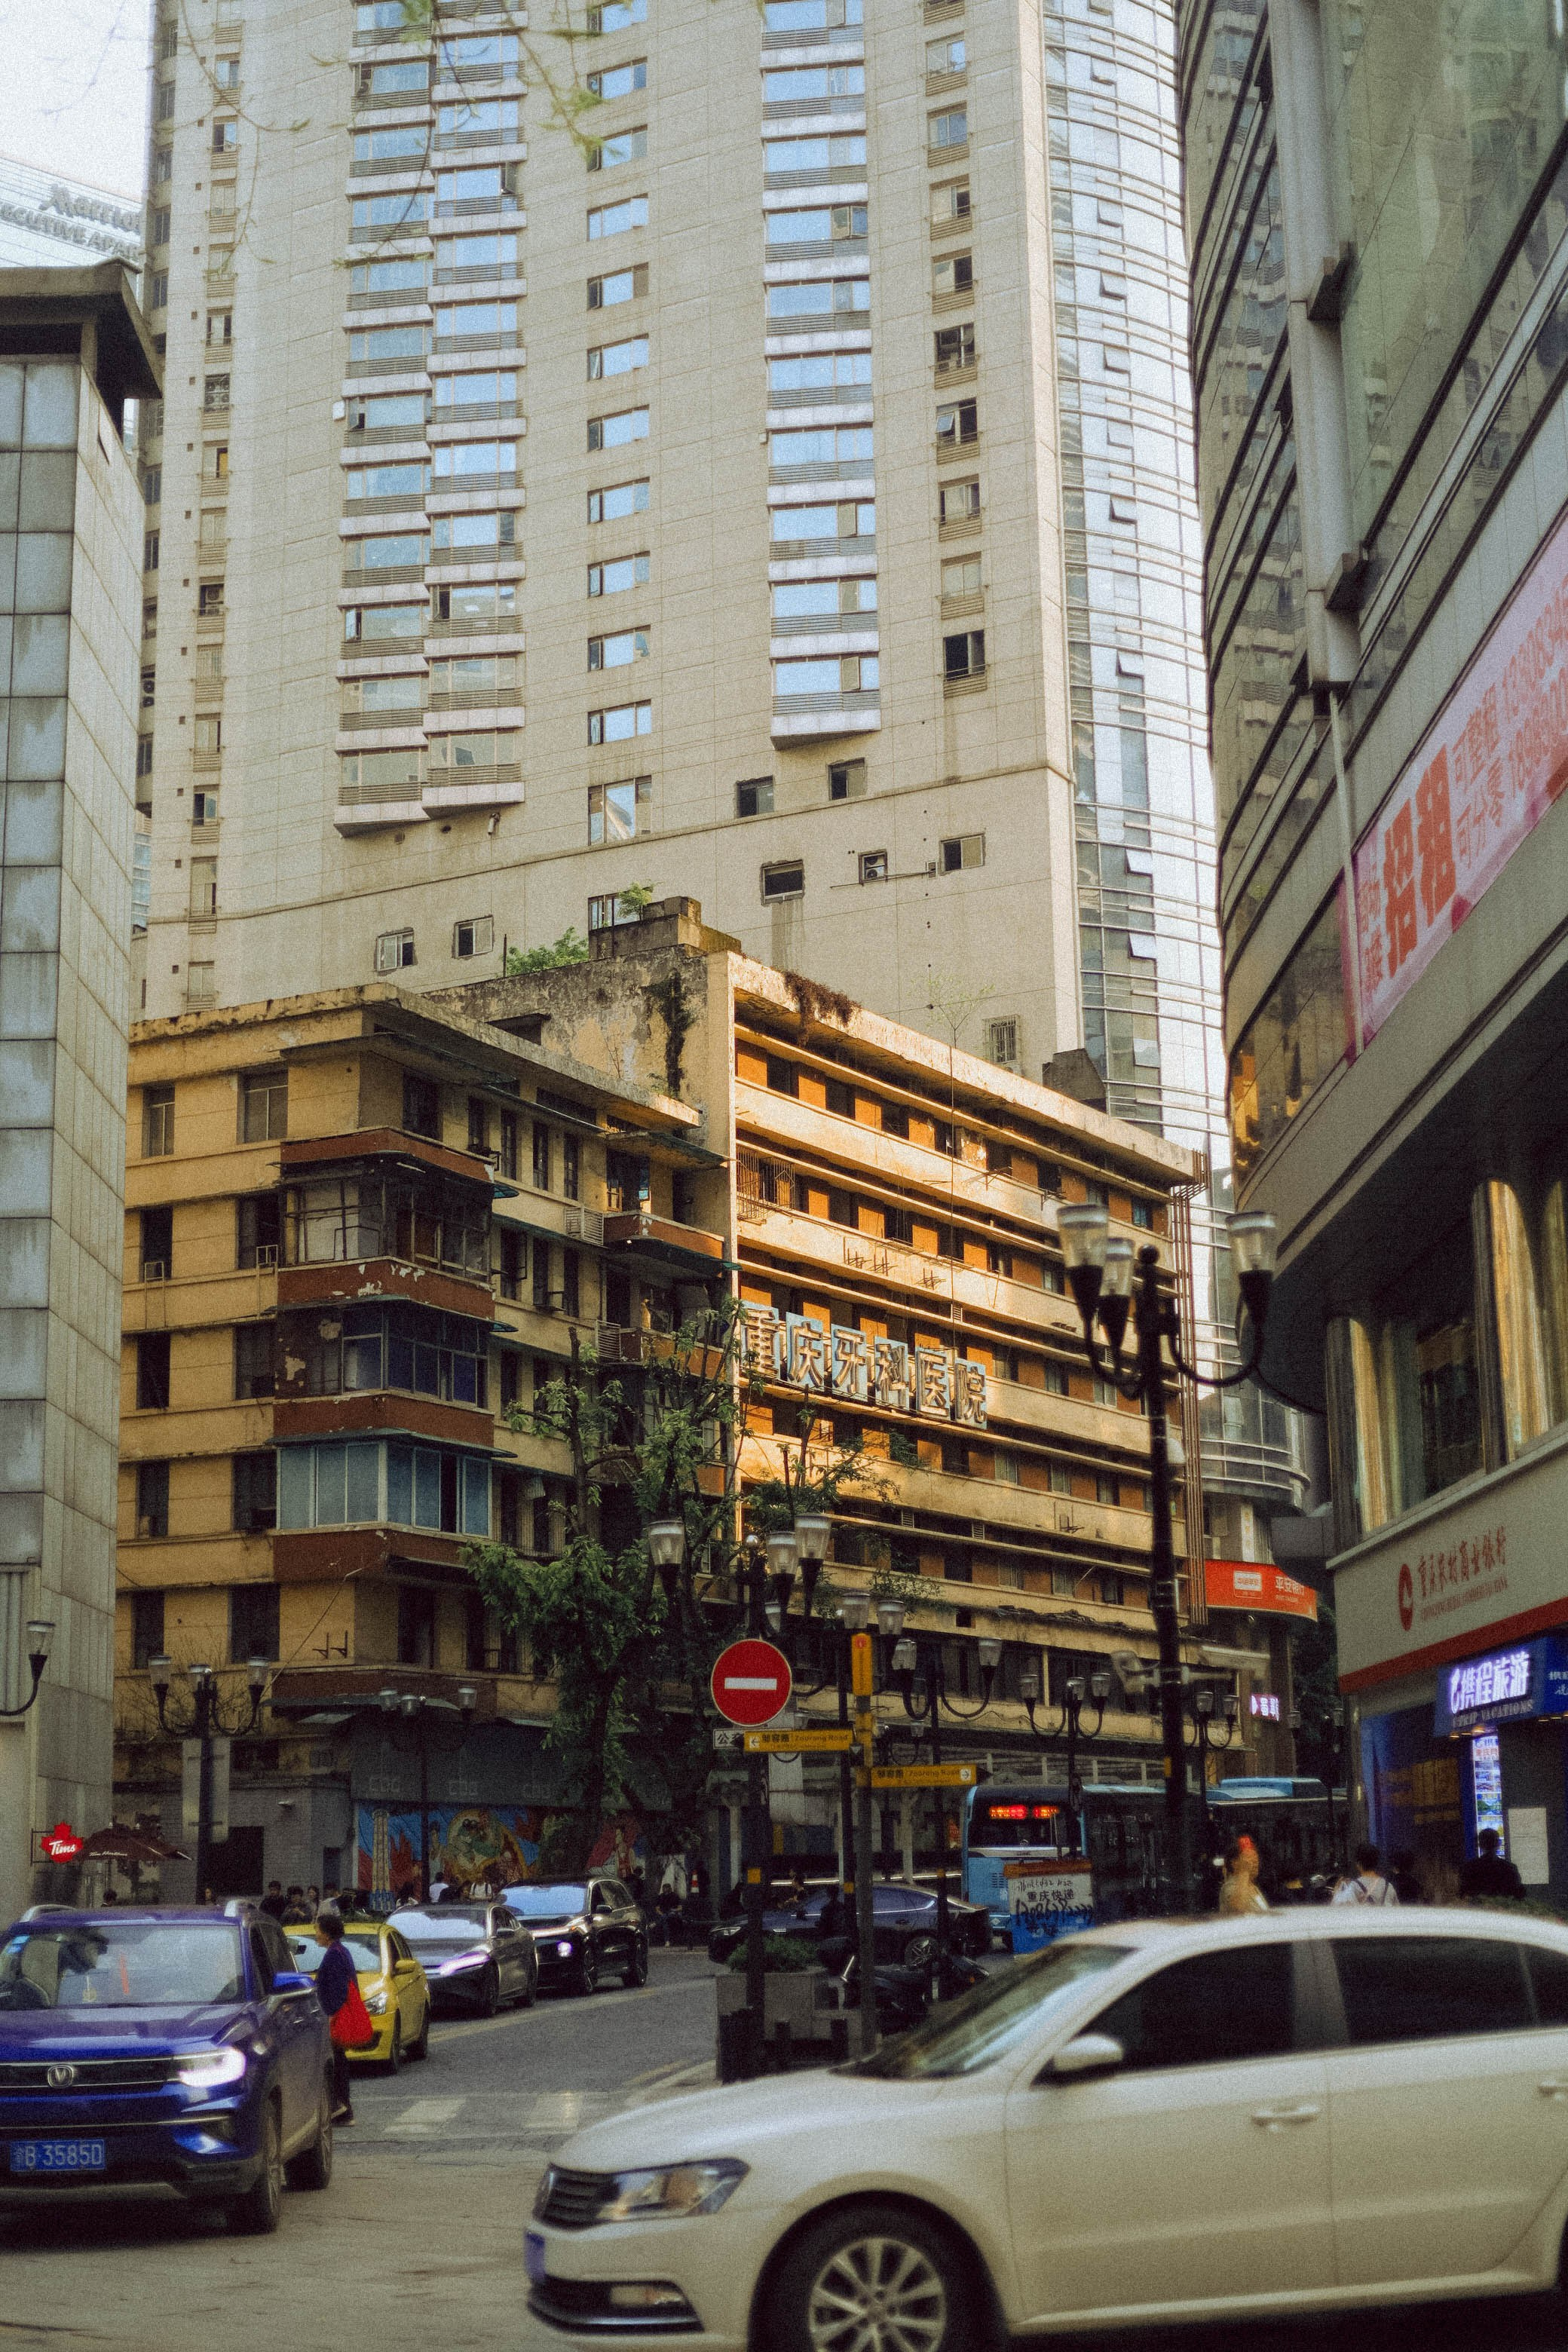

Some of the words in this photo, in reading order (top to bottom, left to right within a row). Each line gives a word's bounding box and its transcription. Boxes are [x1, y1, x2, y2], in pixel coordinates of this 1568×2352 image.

[0, 201, 87, 245] ECUTIVE
[1384, 743, 1456, 978] 招租
[740, 1306, 988, 1424] 重庆牙科医院
[1461, 1650, 1530, 1710] 携程旅游
[48, 1839, 77, 1856] Tims
